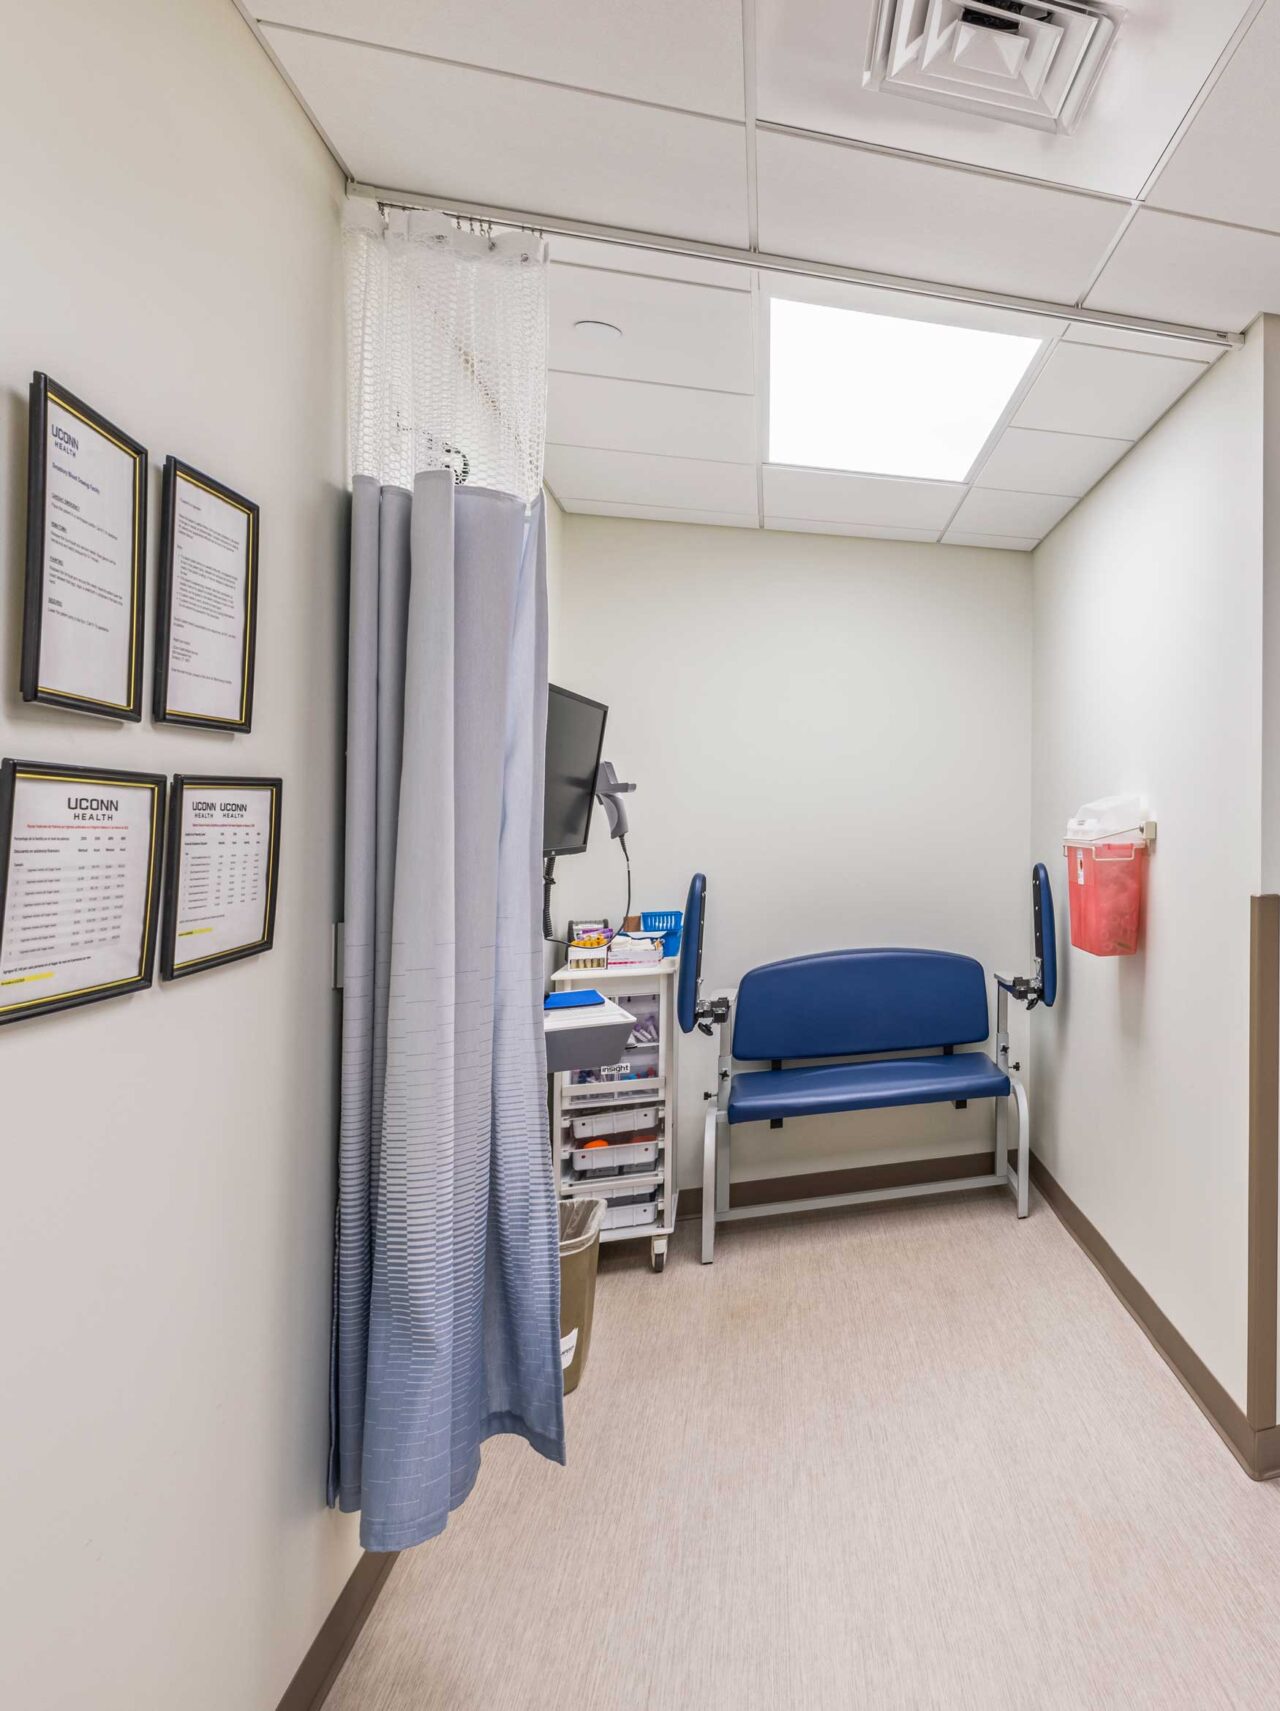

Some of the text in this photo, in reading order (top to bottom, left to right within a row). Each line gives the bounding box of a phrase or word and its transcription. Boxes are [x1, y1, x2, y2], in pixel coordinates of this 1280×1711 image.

[51, 424, 79, 450] UCONN
[54, 441, 77, 458] HEALTH
[67, 797, 119, 812] UCONN
[192, 801, 217, 812] UCONN
[219, 803, 247, 812] UCONN
[73, 813, 114, 821] HEALTH
